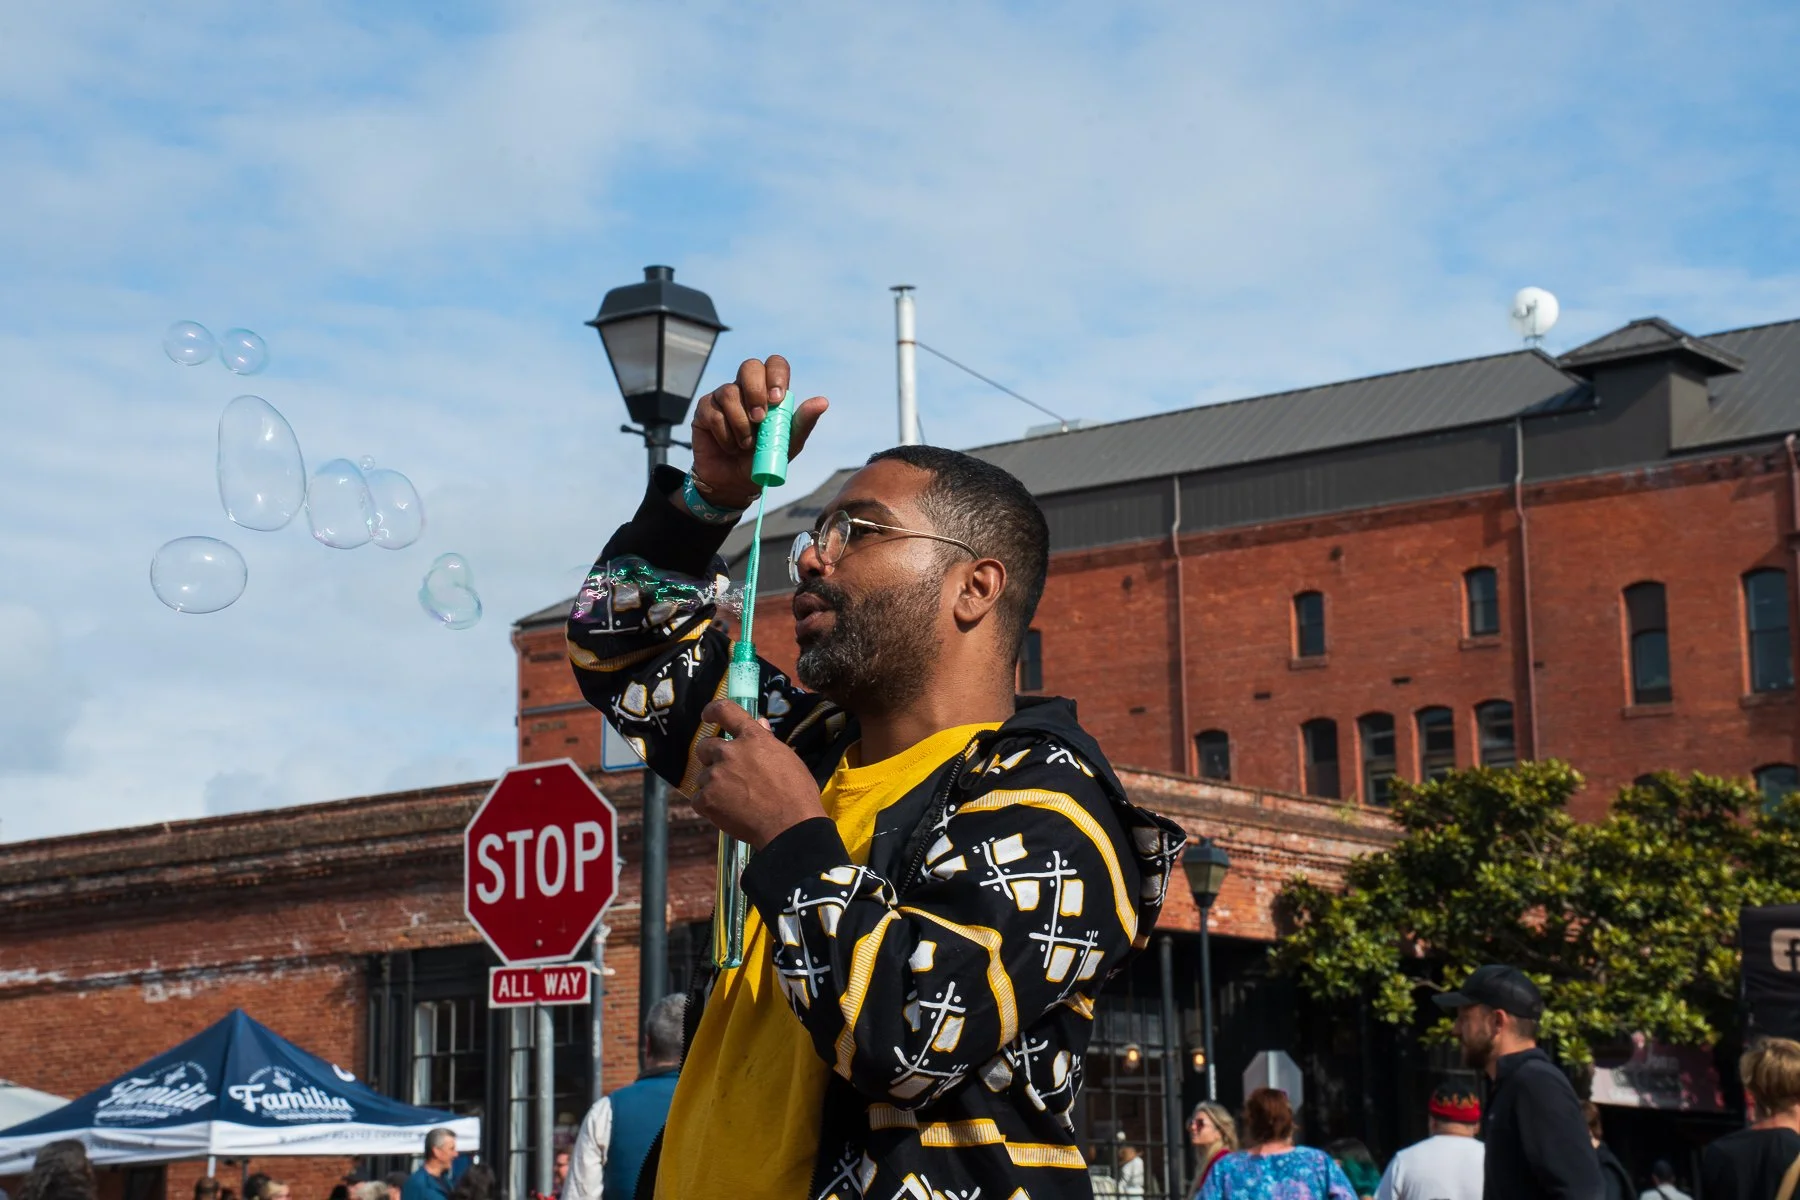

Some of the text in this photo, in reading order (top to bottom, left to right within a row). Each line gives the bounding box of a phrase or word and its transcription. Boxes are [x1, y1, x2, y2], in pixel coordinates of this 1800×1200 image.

[475, 820, 605, 905] STOP
[497, 971, 582, 998] ALL WAY
[97, 1077, 217, 1112] Familia
[228, 1082, 356, 1113] Familia
